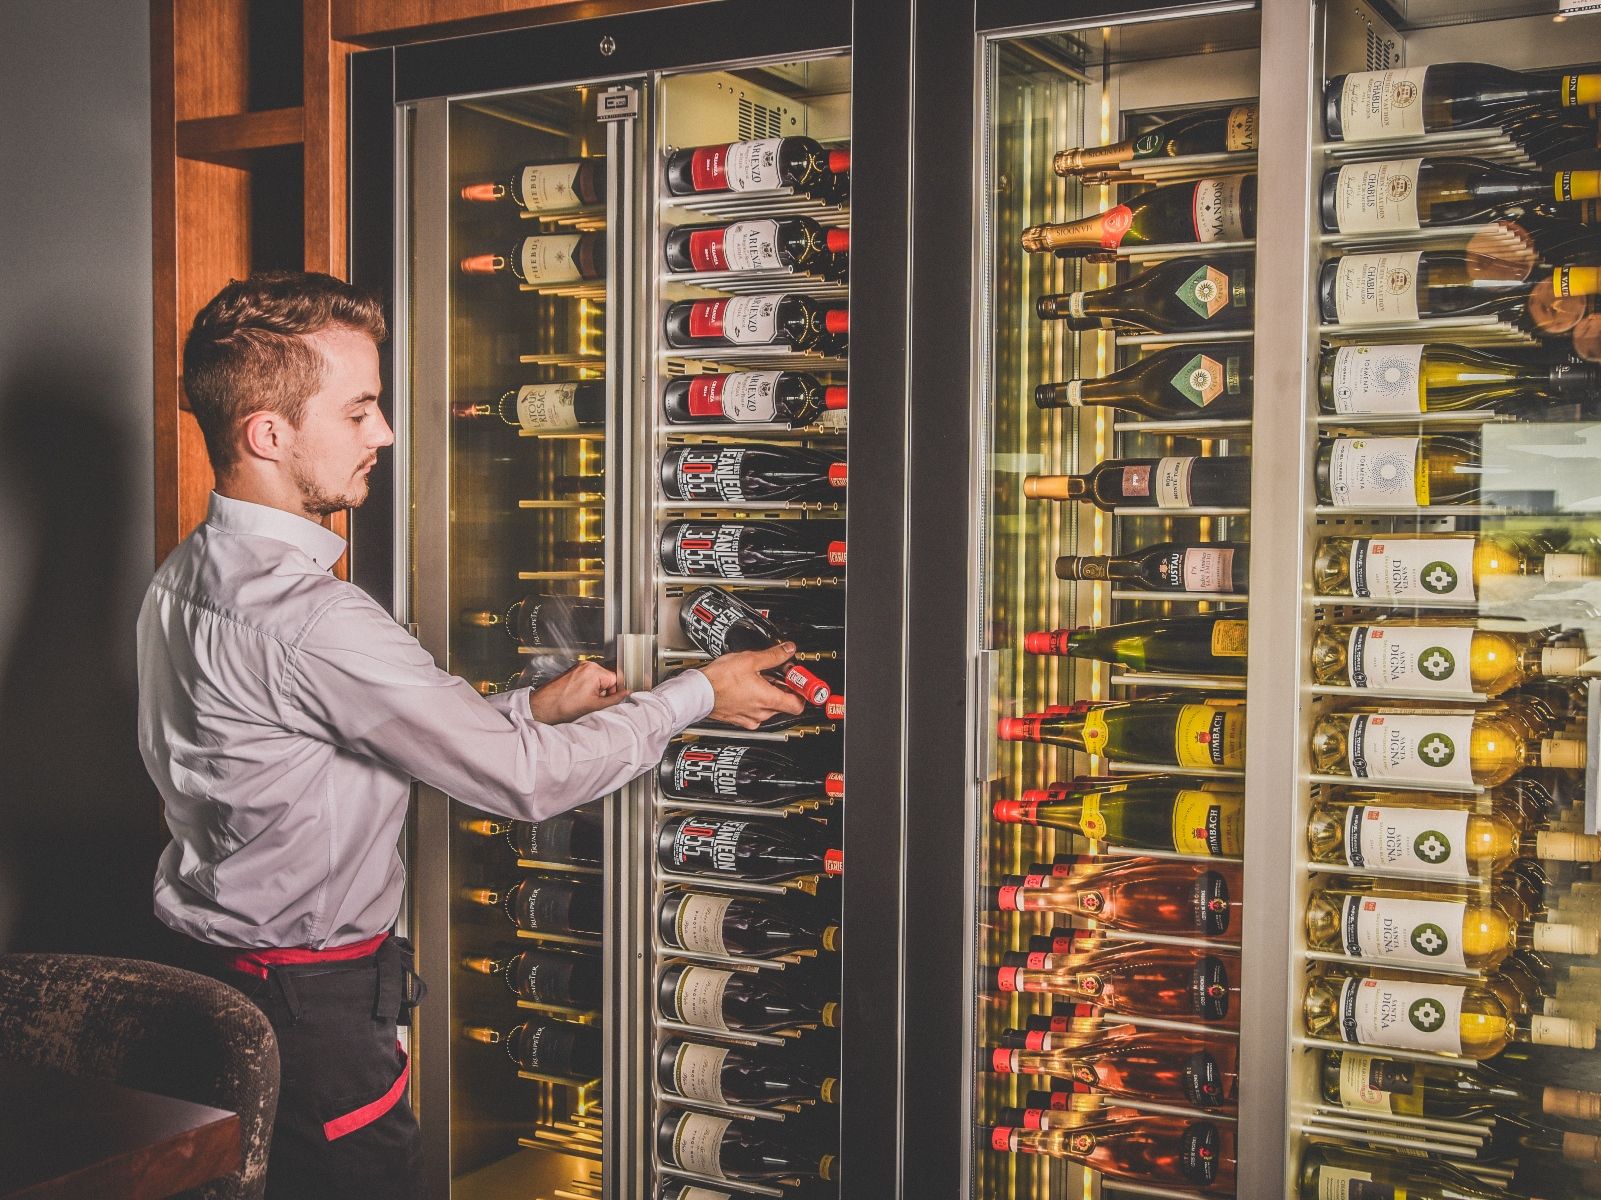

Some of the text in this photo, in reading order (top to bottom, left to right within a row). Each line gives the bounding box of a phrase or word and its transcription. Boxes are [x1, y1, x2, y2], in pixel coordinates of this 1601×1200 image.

[1371, 80, 1383, 114] CHABLIS
[1240, 111, 1254, 151] MANDO
[750, 142, 764, 184] ARIENZO
[1366, 173, 1377, 207] CHABLIS
[1212, 181, 1225, 238] MANDOIS
[711, 241, 719, 266] CRIANZA
[749, 229, 762, 269] ARIENZ
[1366, 266, 1377, 300] CHABLIS
[711, 302, 719, 323] CRIANZA
[747, 295, 766, 333] ARIENZO
[528, 390, 540, 428] LATOUR
[537, 390, 548, 423] RISSAC
[710, 380, 718, 403] CRIANZA
[747, 374, 763, 412] ARIENZO
[682, 454, 719, 493] 3055
[680, 530, 718, 569] 3055
[1170, 553, 1180, 586] LUSTAU
[1392, 560, 1403, 595] DIGNA
[530, 604, 542, 645] TRUMPETER
[691, 599, 722, 645] 3055
[714, 606, 744, 634] JEAN
[1390, 644, 1399, 680] DIGNA
[1212, 715, 1223, 762] TRIMBACH
[1390, 730, 1400, 767] DIGNA
[684, 745, 721, 782] 3055
[530, 822, 539, 855] TRUMPE
[682, 819, 720, 857] 3055
[1209, 808, 1218, 853] TRIMBACH
[1386, 826, 1396, 862] DIGNA
[529, 887, 541, 929] TRUMPETER
[1383, 918, 1393, 953] DIGNA
[692, 982, 700, 1001] PINOT
[1381, 992, 1392, 1030] DIGNA
[532, 1026, 546, 1068] TRUMPETER
[690, 1129, 698, 1147] PINOT
